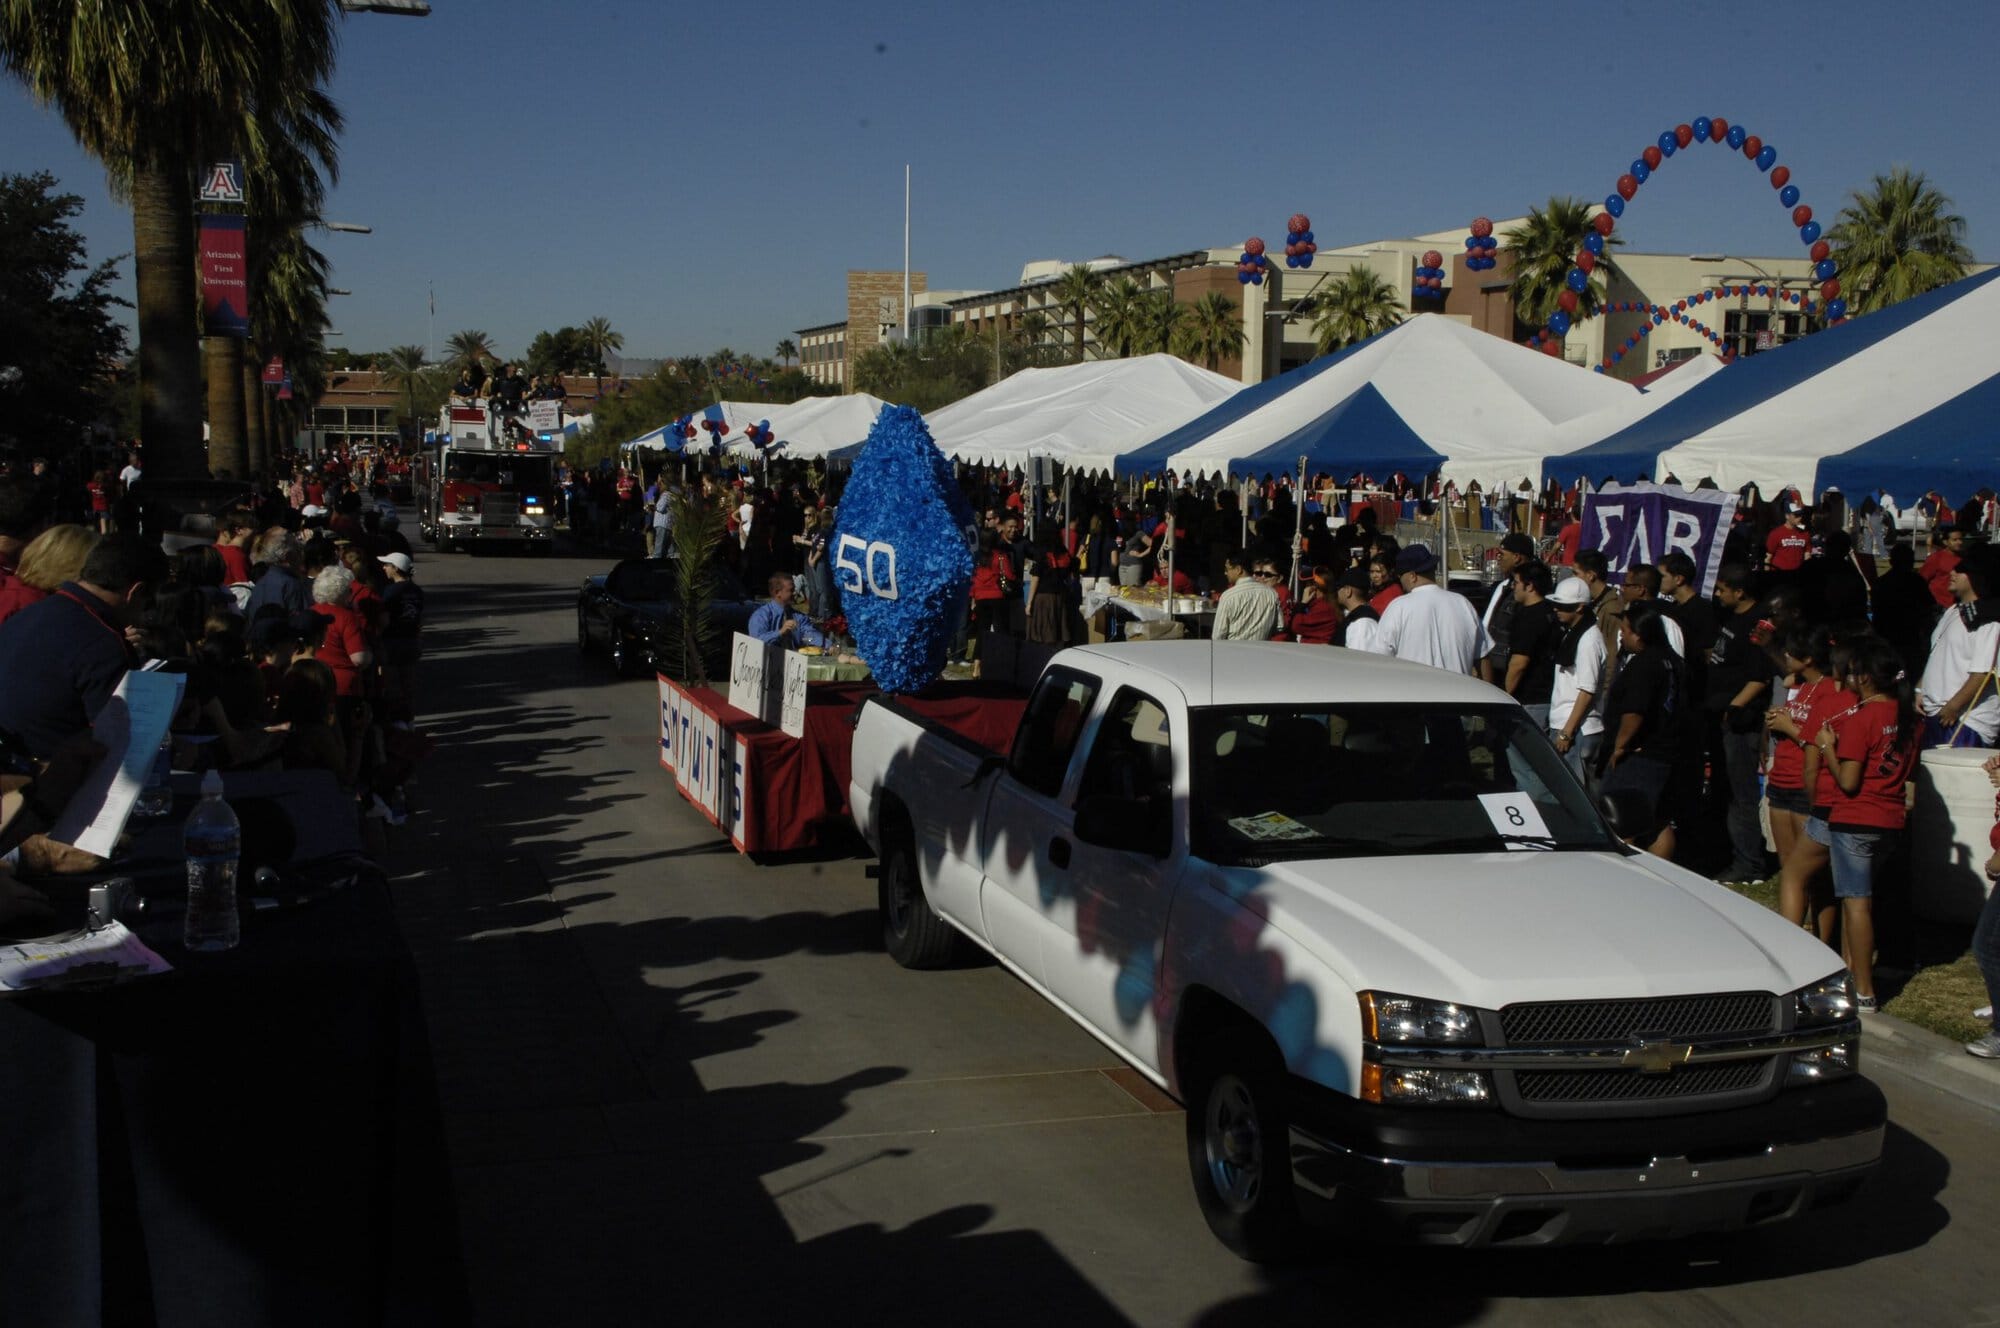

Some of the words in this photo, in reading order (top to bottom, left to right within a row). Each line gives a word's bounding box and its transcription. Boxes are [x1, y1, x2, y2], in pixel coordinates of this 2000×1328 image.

[201, 163, 244, 201] A
[214, 264, 233, 272] First
[836, 532, 899, 601] 50
[1505, 805, 1525, 826] 8
